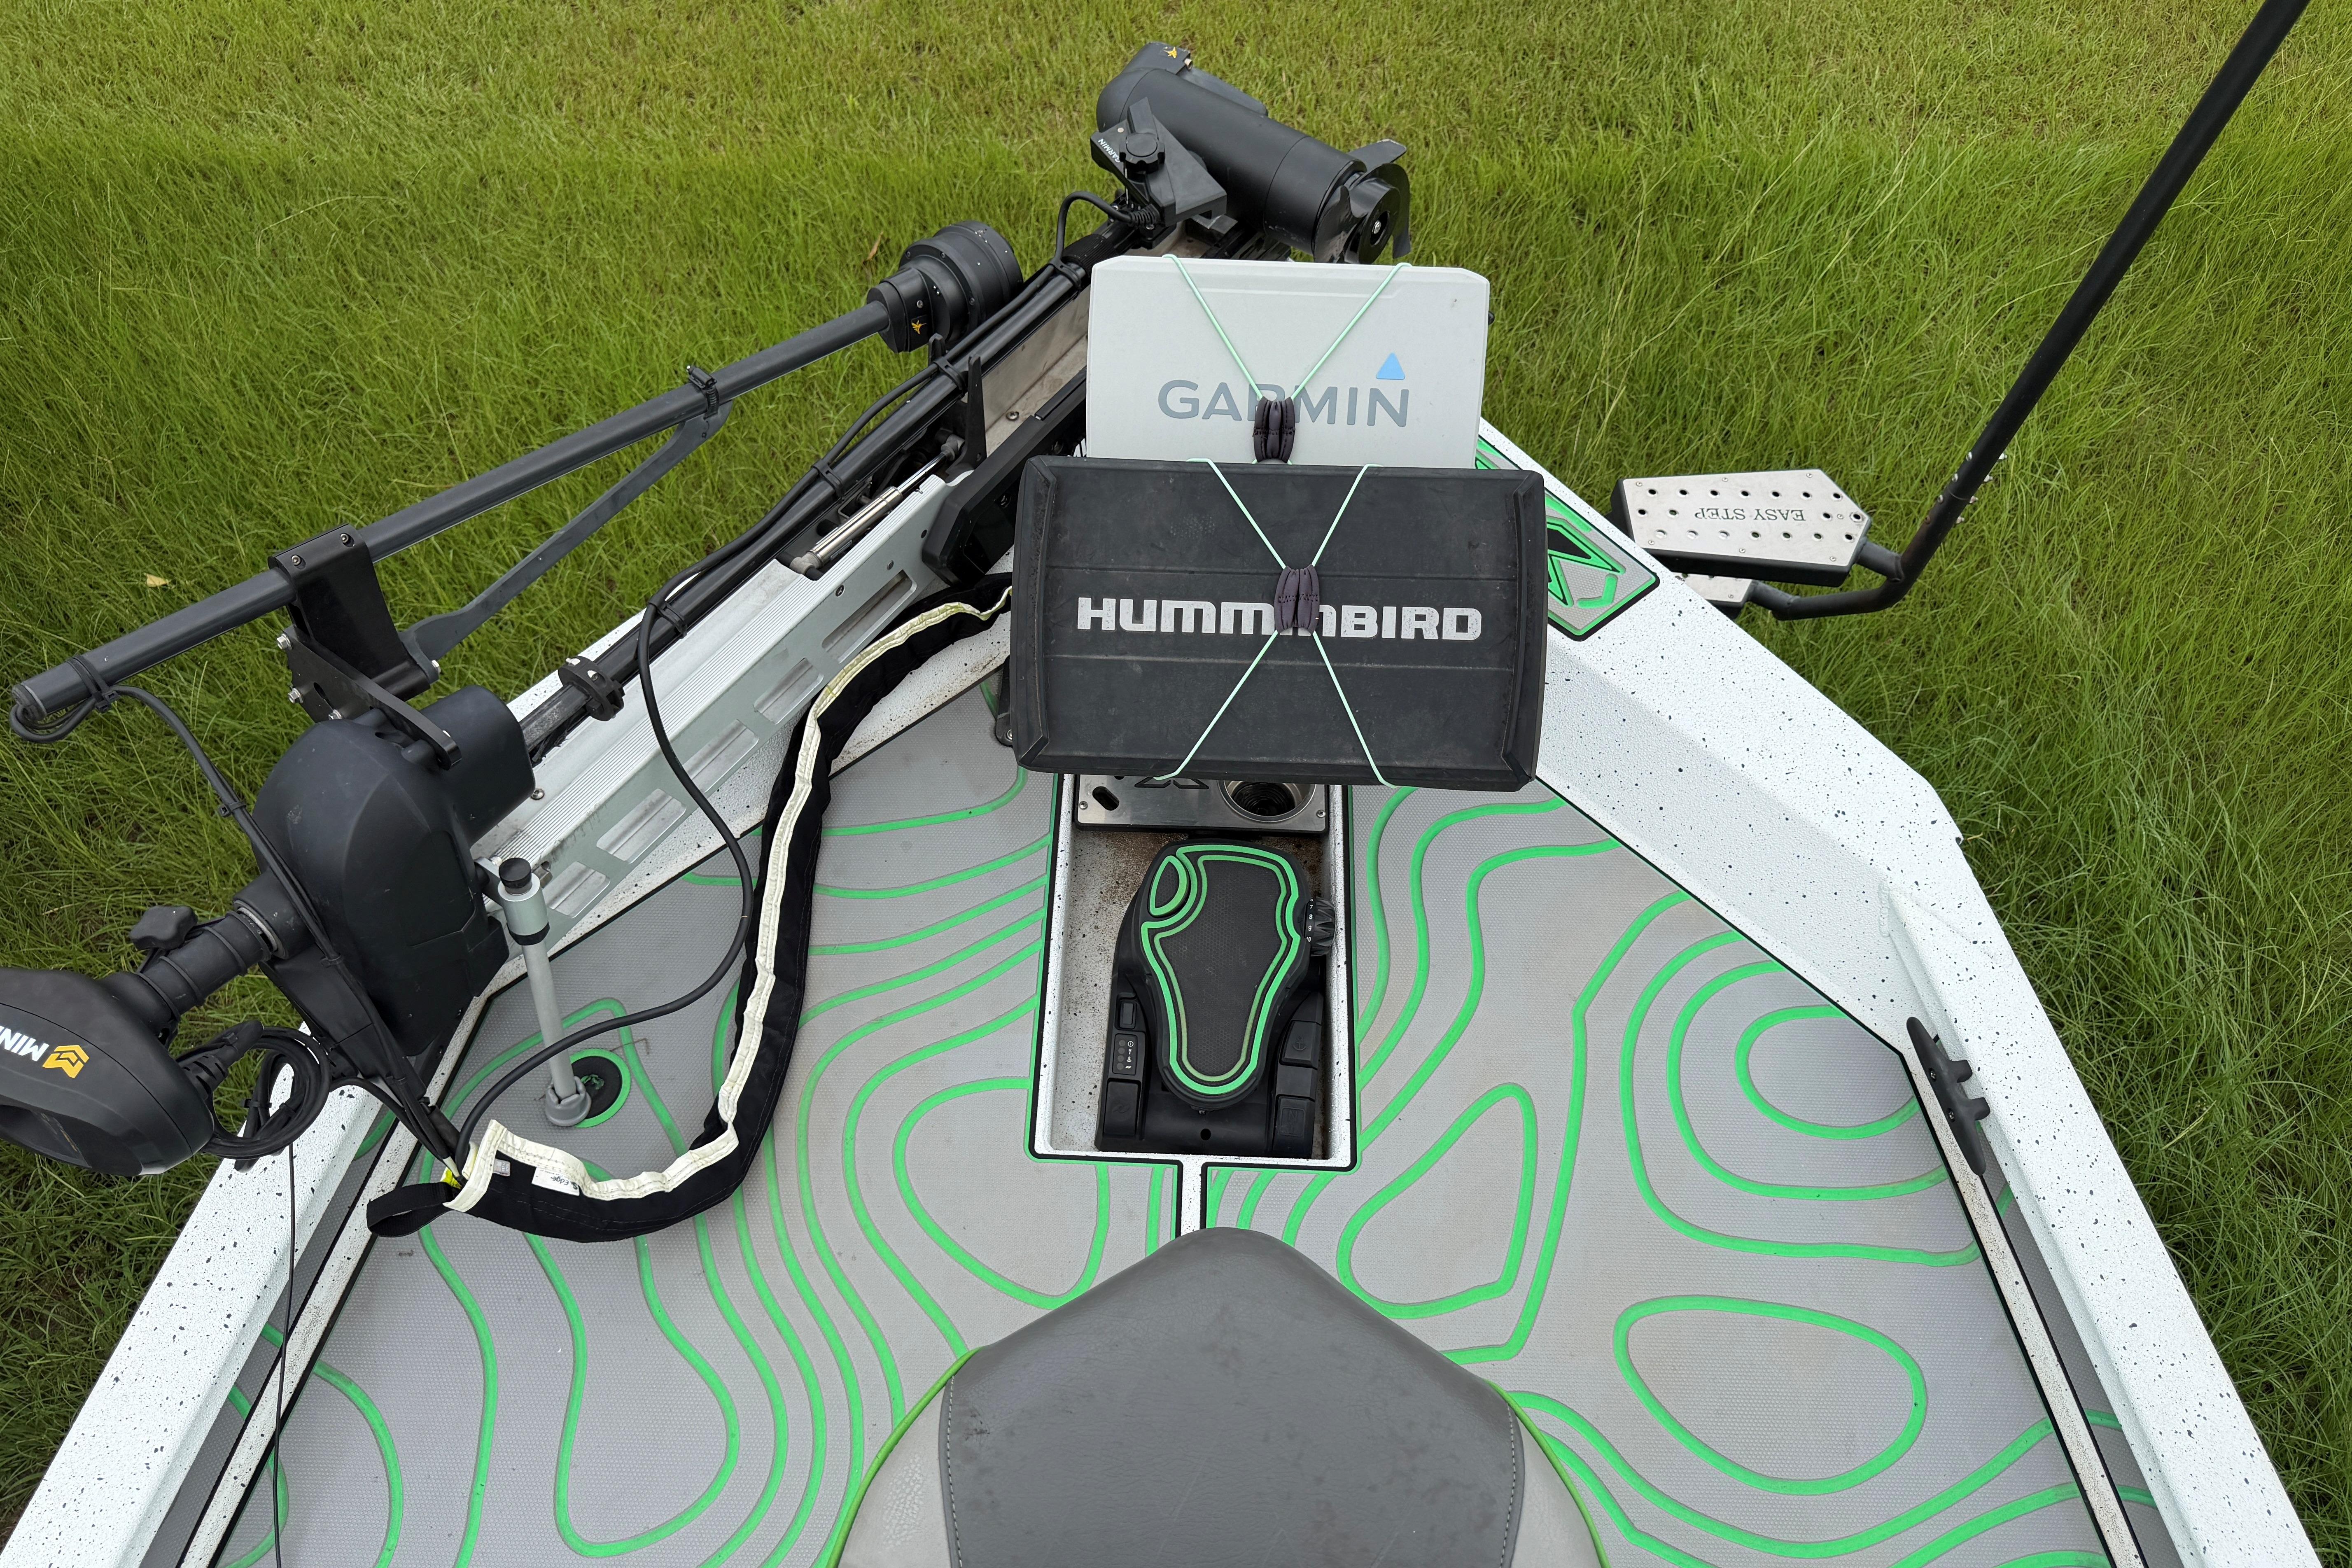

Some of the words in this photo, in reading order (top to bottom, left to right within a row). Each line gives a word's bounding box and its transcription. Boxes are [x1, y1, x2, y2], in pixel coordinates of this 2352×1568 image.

[1694, 508, 1746, 520] STEP
[1753, 509, 1806, 521] EASY
[1077, 597, 1482, 640] HUMMNBIRD
